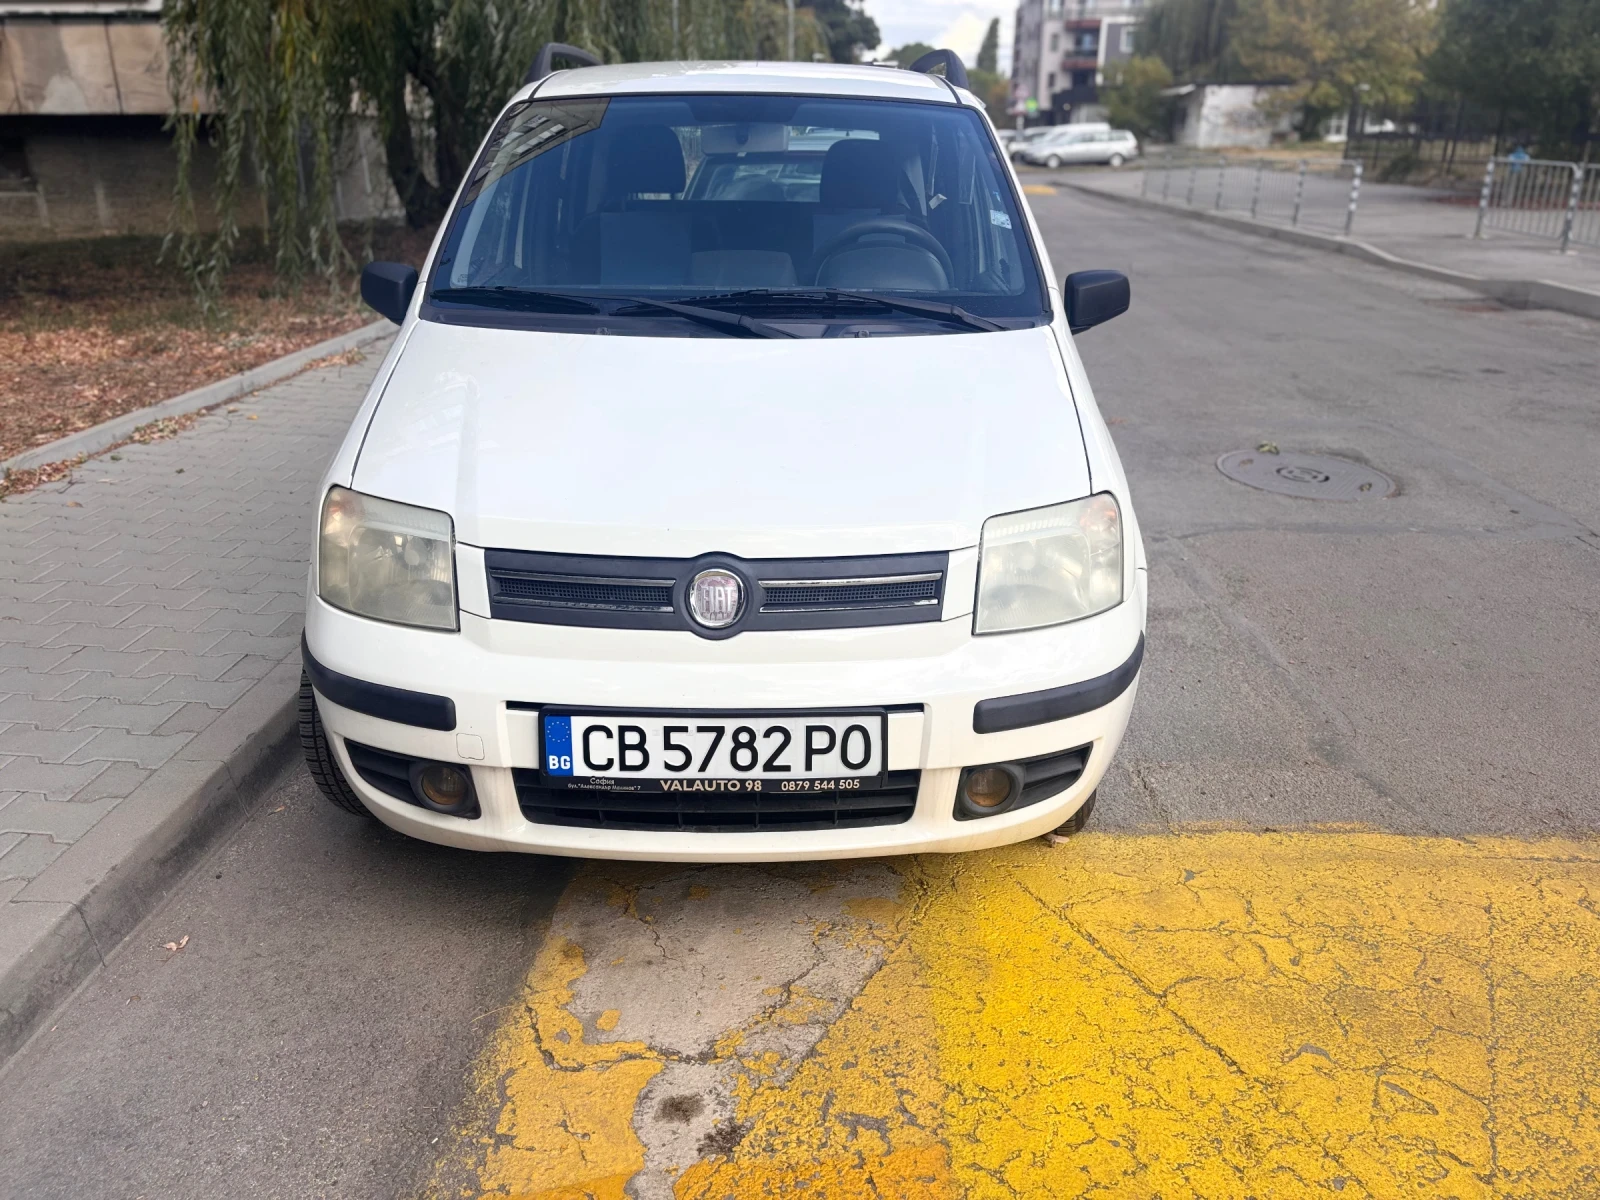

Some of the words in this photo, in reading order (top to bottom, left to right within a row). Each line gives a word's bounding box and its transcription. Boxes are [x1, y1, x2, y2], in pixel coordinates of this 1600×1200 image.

[701, 585, 734, 613] FIAT
[582, 725, 650, 772] CB
[664, 725, 792, 773] 5782
[804, 723, 872, 771] PO
[548, 755, 571, 770] BG
[590, 777, 615, 786] София
[660, 780, 740, 792] VALAUTO
[745, 780, 763, 792] 98
[781, 781, 810, 791] 0879
[813, 780, 836, 790] 544
[838, 779, 861, 789] 505
